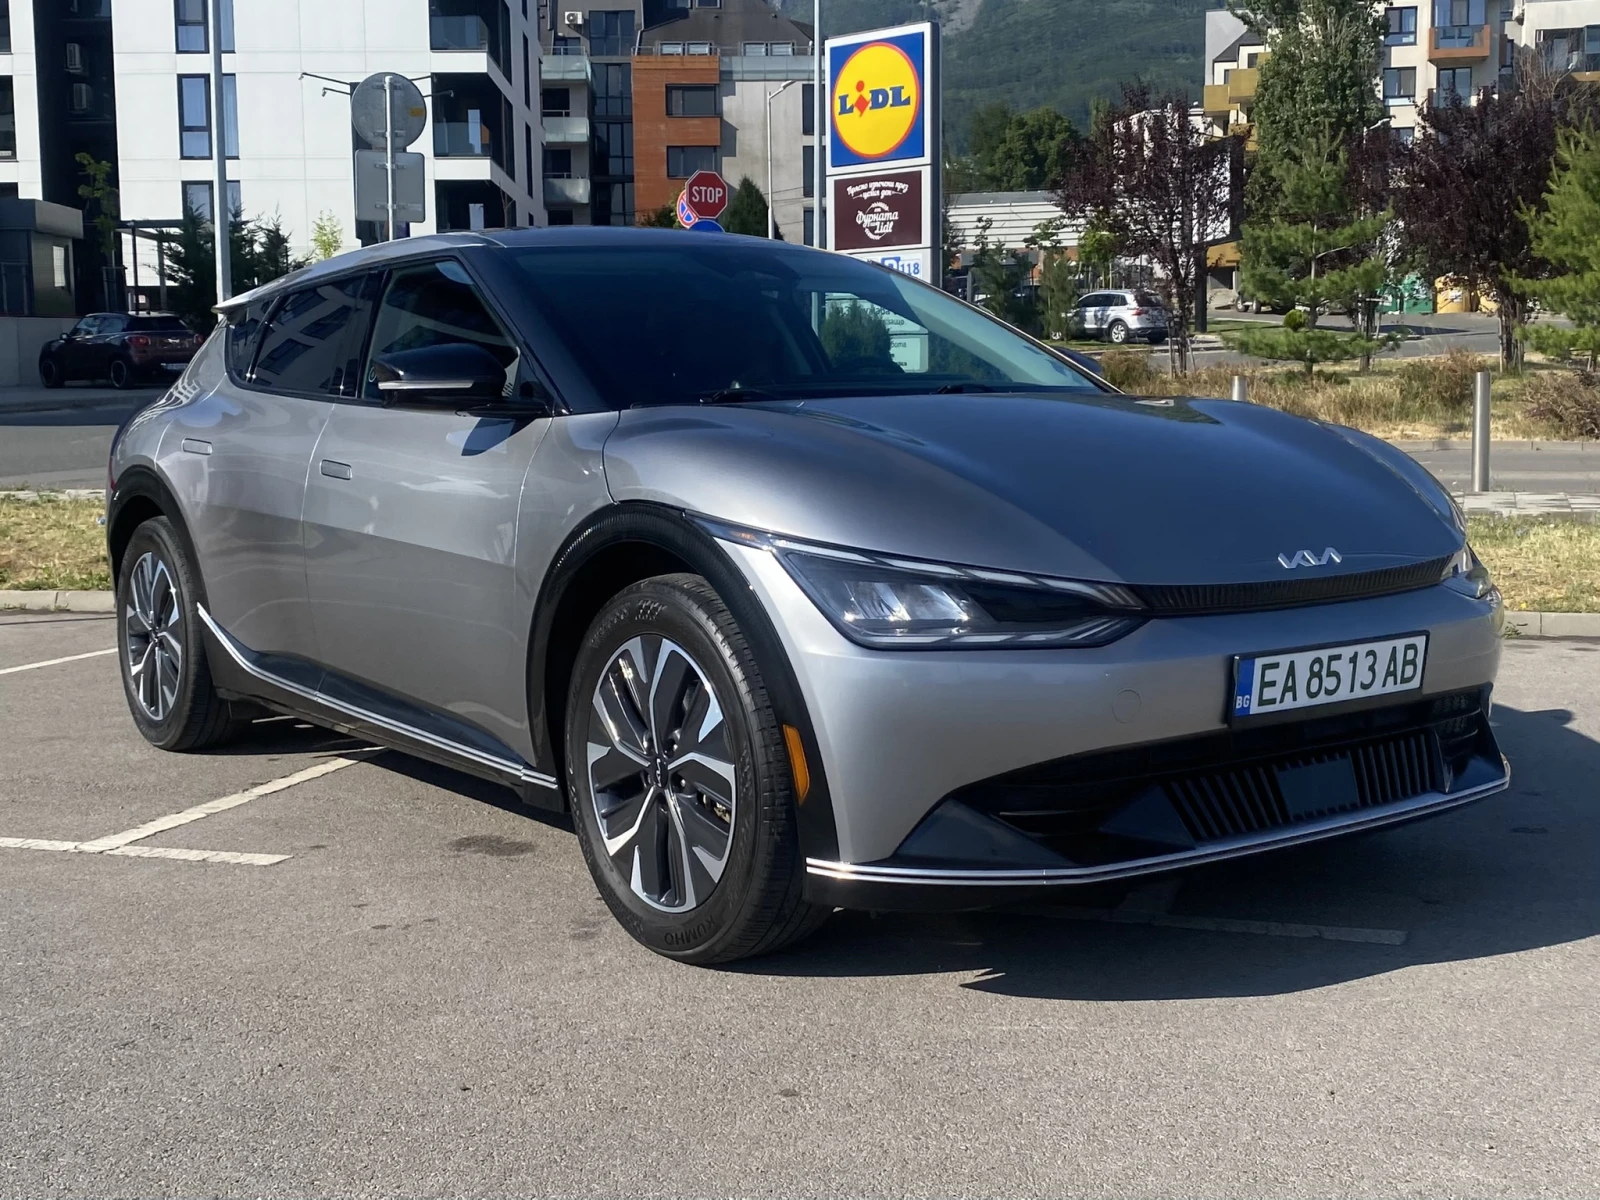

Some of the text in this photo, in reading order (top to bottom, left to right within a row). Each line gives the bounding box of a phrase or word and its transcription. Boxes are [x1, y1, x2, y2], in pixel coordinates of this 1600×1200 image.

[691, 185, 723, 204] STOP
[855, 210, 899, 228] Фурната
[1257, 643, 1418, 707] EA 8513 AB
[1235, 695, 1250, 709] BG
[664, 914, 716, 946] KUMHO
